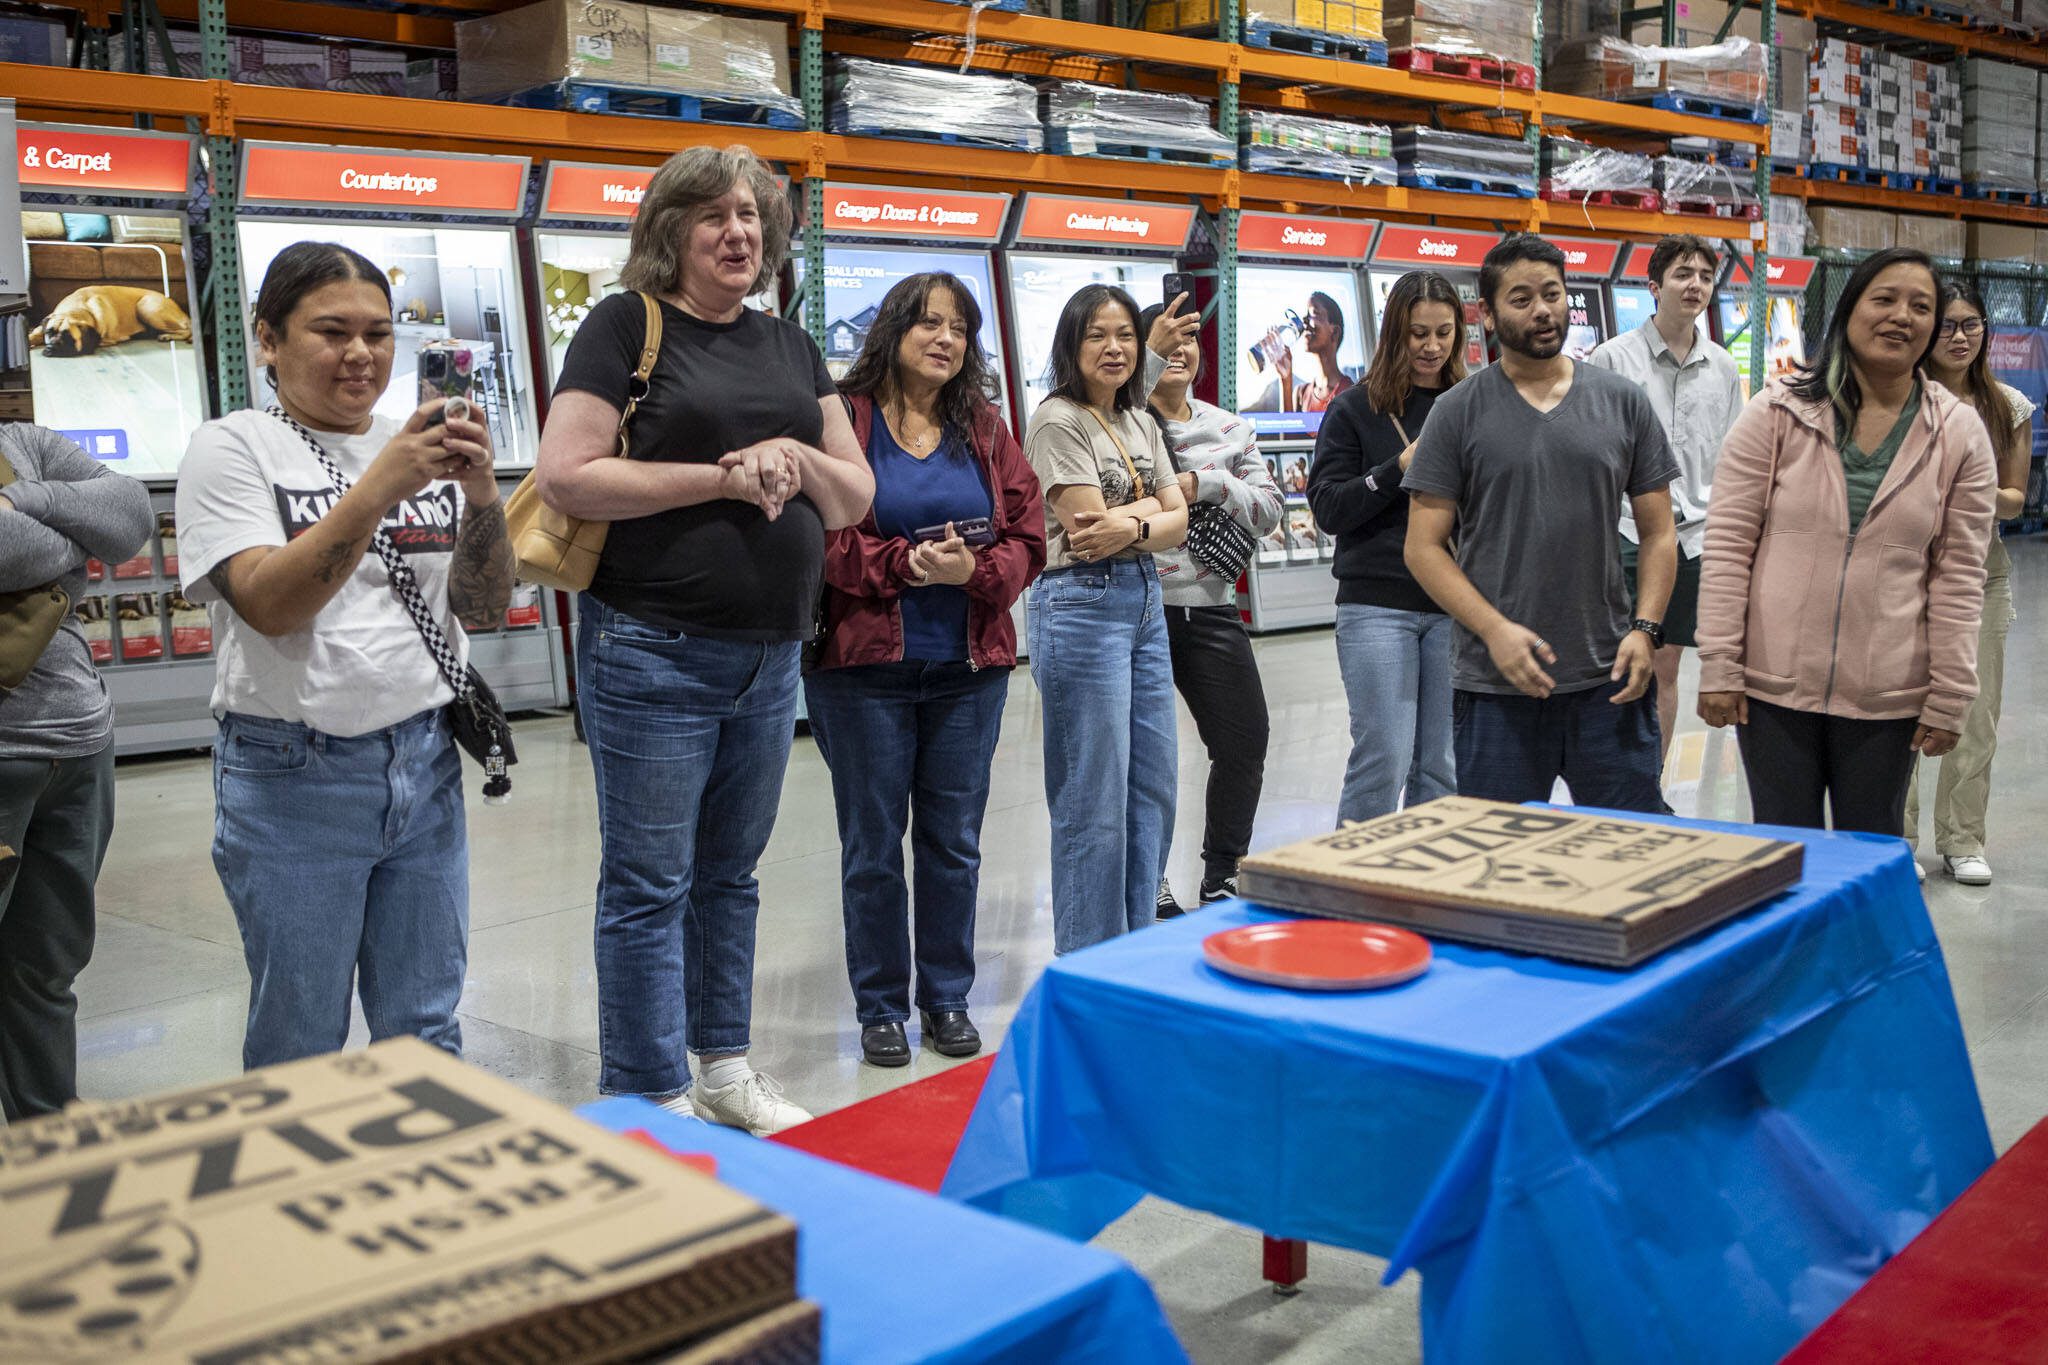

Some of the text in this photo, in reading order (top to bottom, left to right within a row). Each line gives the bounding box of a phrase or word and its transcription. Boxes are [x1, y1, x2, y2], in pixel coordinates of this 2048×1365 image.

[242, 41, 260, 54] 50
[332, 49, 349, 62] 50
[23, 145, 112, 174] & Carpet
[340, 168, 437, 195] Countertops
[834, 200, 979, 226] Garage Doors & Openers
[1281, 226, 1327, 246] Services
[1417, 238, 1457, 257] Services
[1329, 816, 1444, 851] COSTCO
[1340, 808, 1580, 872] PIZZA
